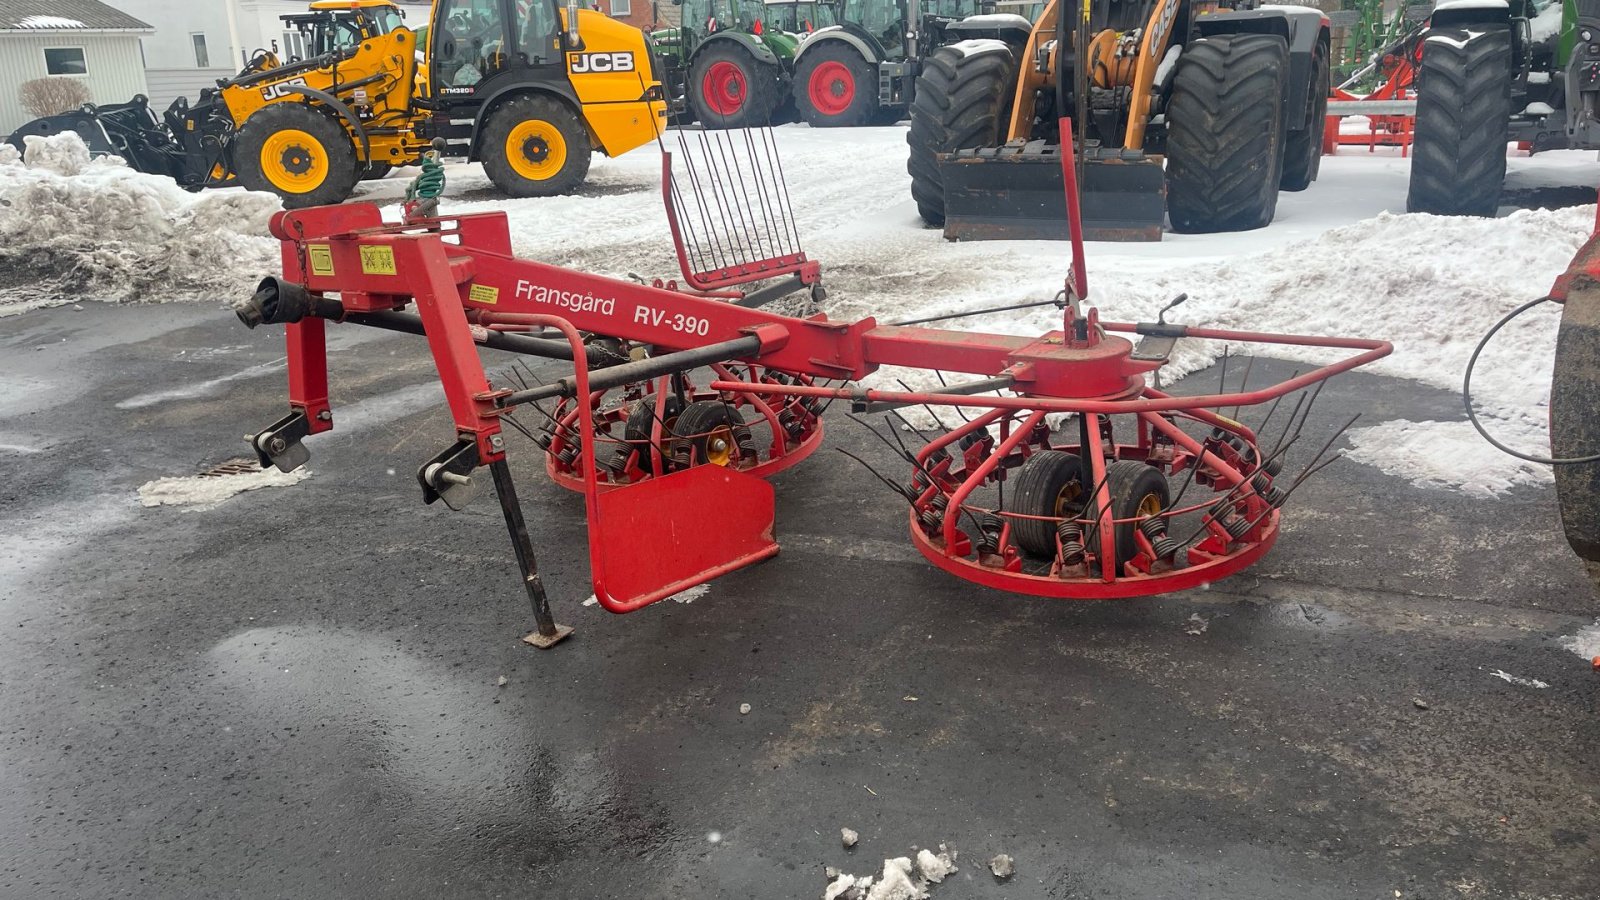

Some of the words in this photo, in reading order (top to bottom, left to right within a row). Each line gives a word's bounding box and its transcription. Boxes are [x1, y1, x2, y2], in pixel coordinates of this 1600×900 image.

[271, 39, 278, 54] 5
[572, 53, 633, 72] JCB
[515, 279, 616, 316] Fransgård
[634, 305, 709, 336] RV-390
